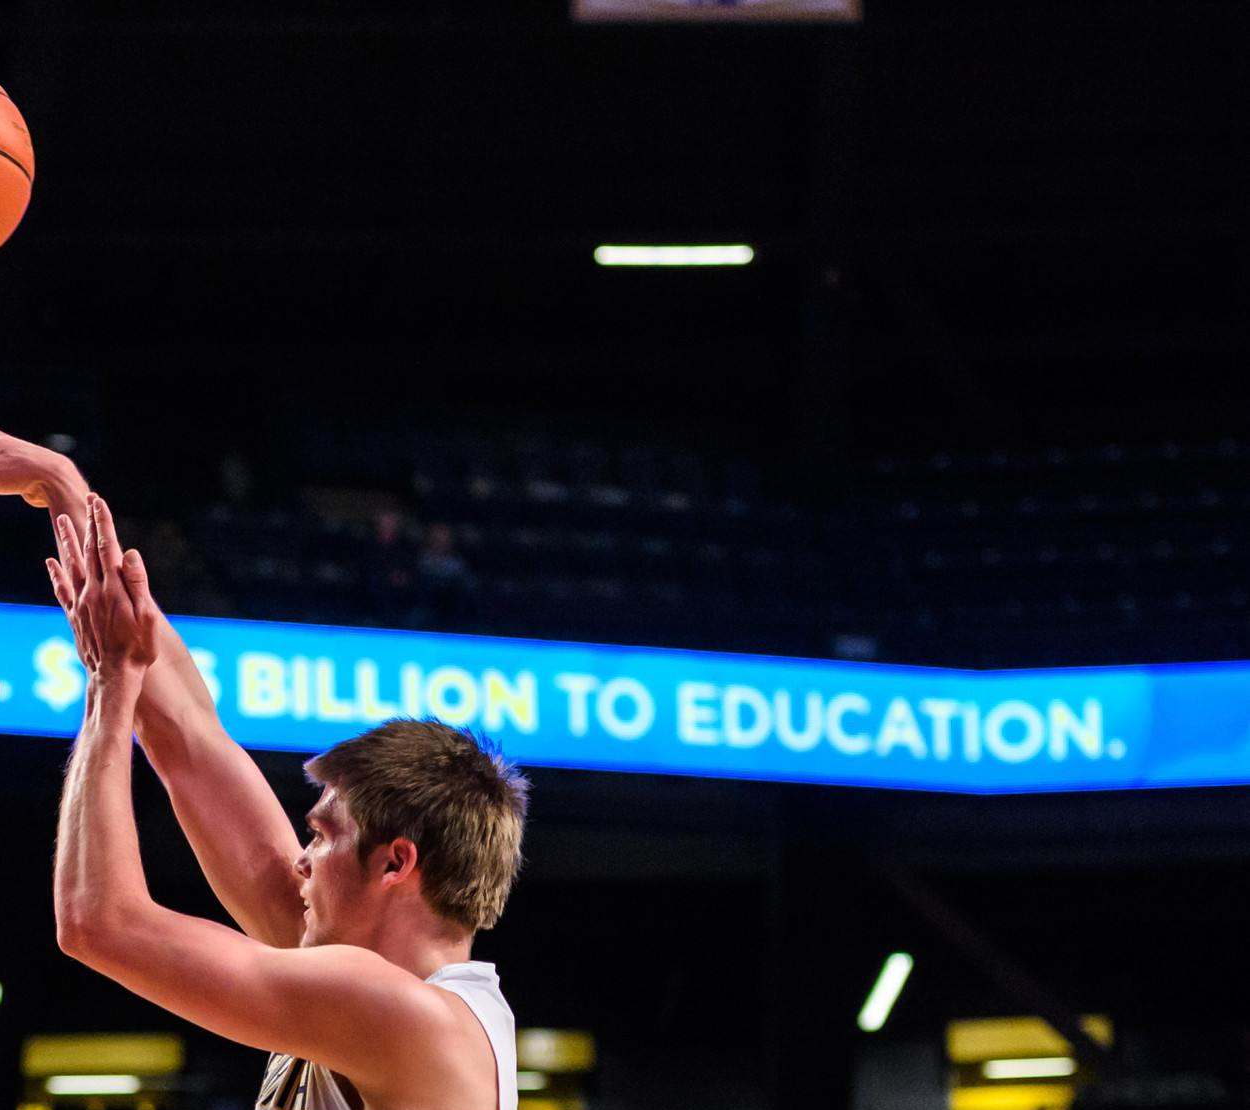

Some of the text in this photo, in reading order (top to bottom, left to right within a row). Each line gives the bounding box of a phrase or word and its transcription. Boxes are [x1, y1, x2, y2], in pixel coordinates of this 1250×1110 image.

[237, 650, 538, 732] BILLION
[554, 670, 655, 740] TO
[674, 677, 1128, 763] EDUCATION.
